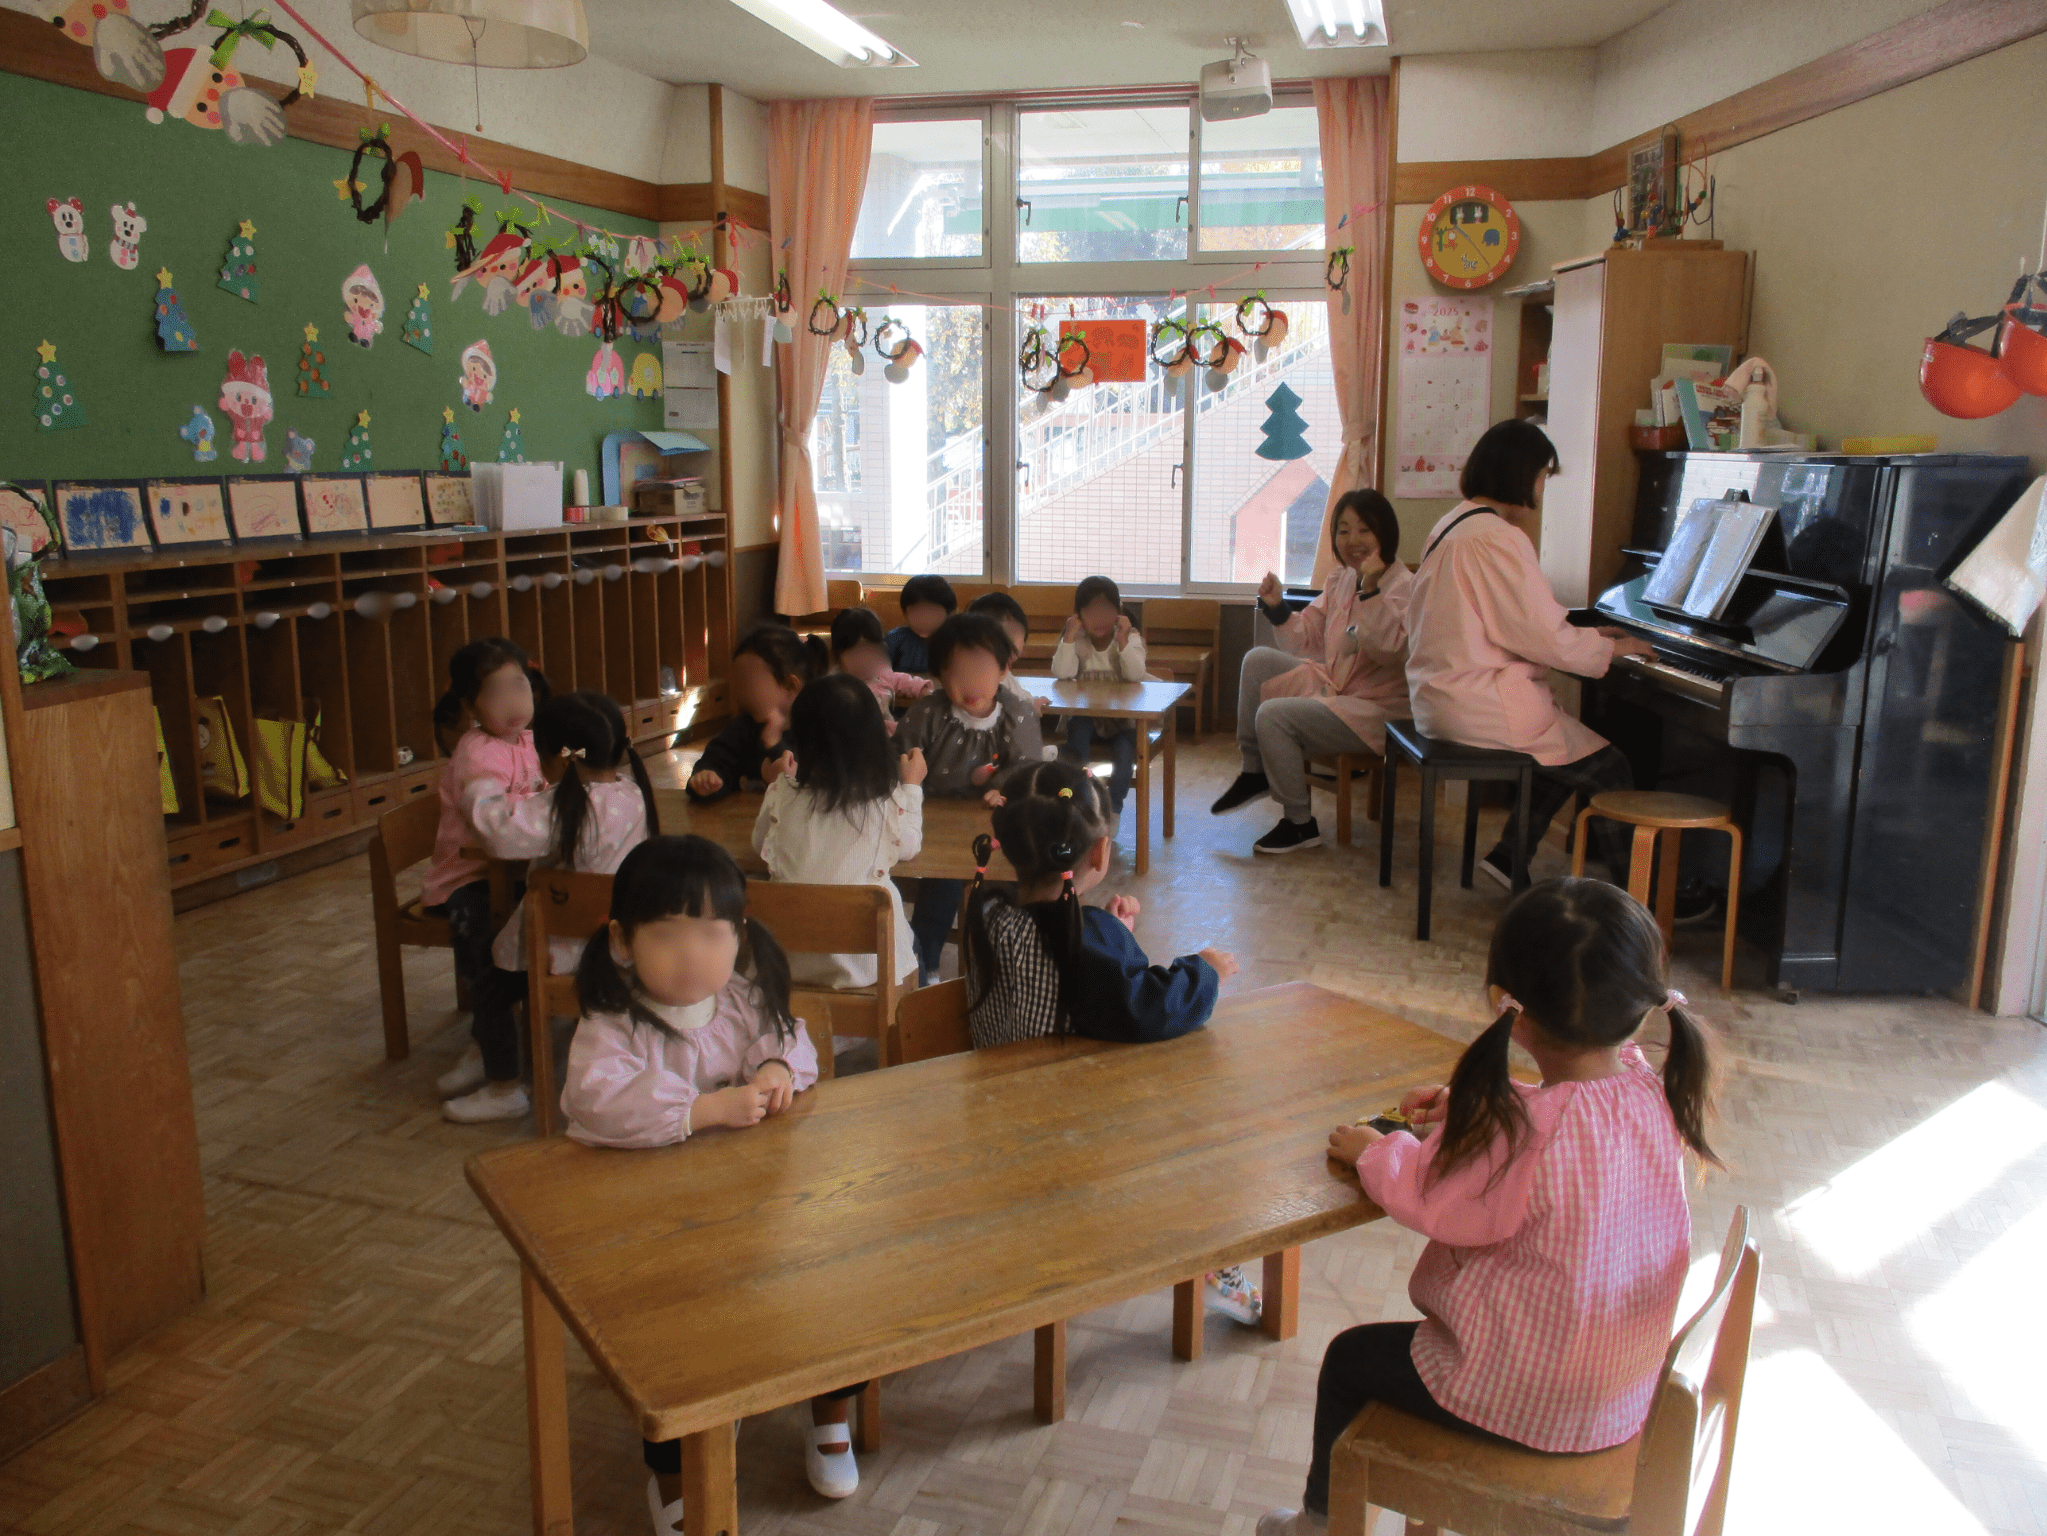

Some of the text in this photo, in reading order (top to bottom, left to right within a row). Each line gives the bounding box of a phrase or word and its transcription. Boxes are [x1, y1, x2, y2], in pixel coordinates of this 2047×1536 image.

[1422, 236, 1427, 244] 9
[1512, 232, 1517, 240] 3
[1504, 255, 1510, 263] 4
[1465, 279, 1471, 287] 6
[1434, 308, 1459, 316] 2025
